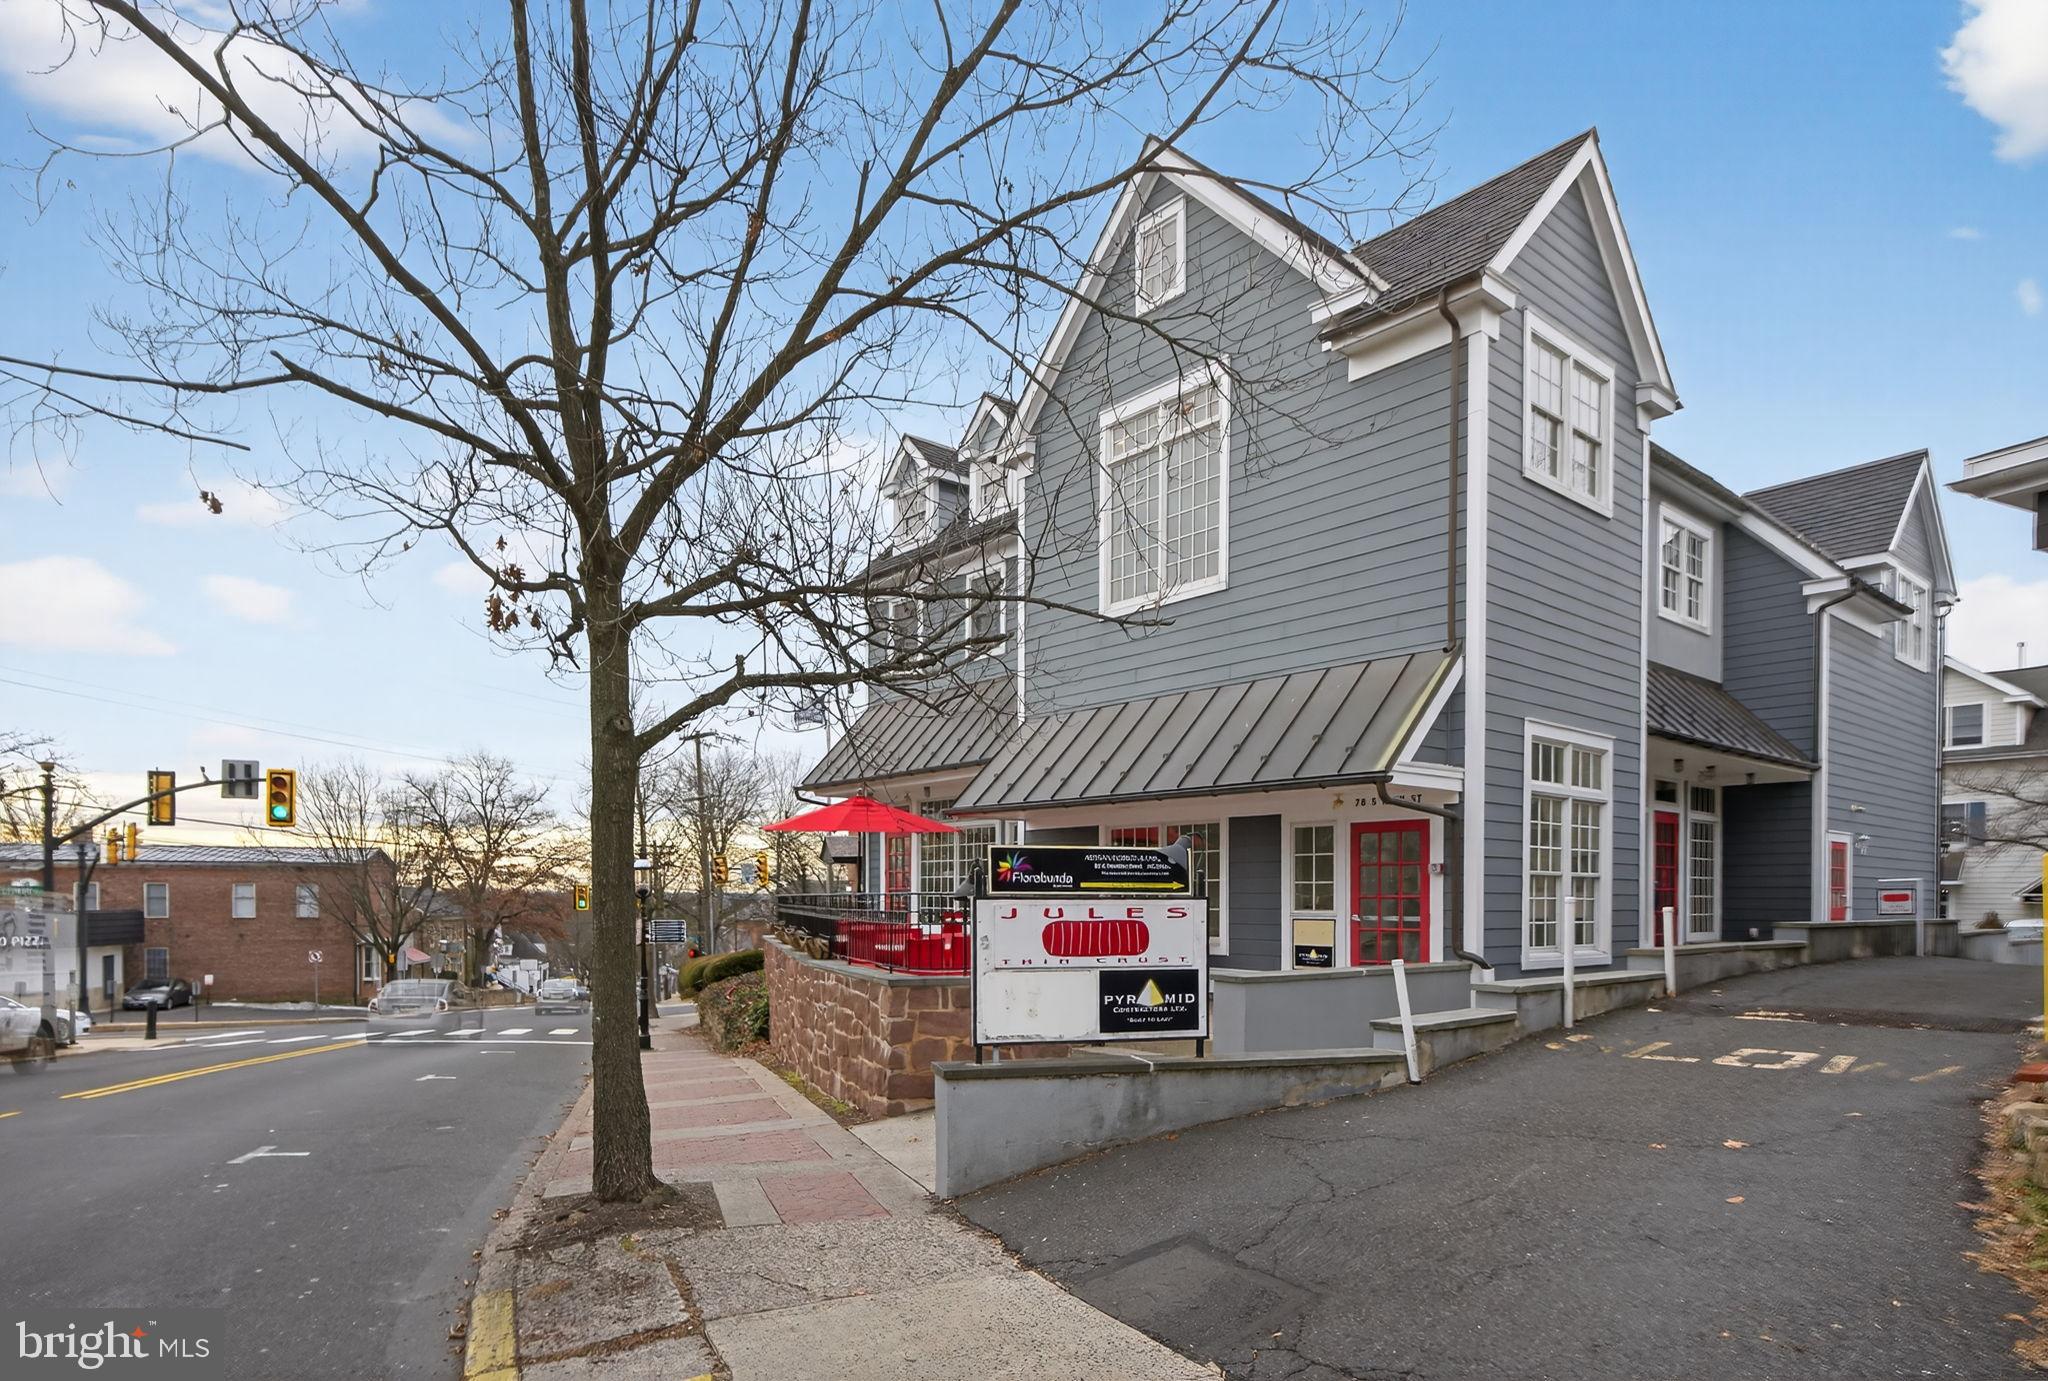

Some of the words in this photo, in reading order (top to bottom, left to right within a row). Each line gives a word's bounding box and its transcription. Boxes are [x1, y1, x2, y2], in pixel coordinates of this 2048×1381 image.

[1001, 907, 1188, 919] JULES
[1002, 958, 1069, 966] THIN
[1096, 956, 1188, 964] CRUST
